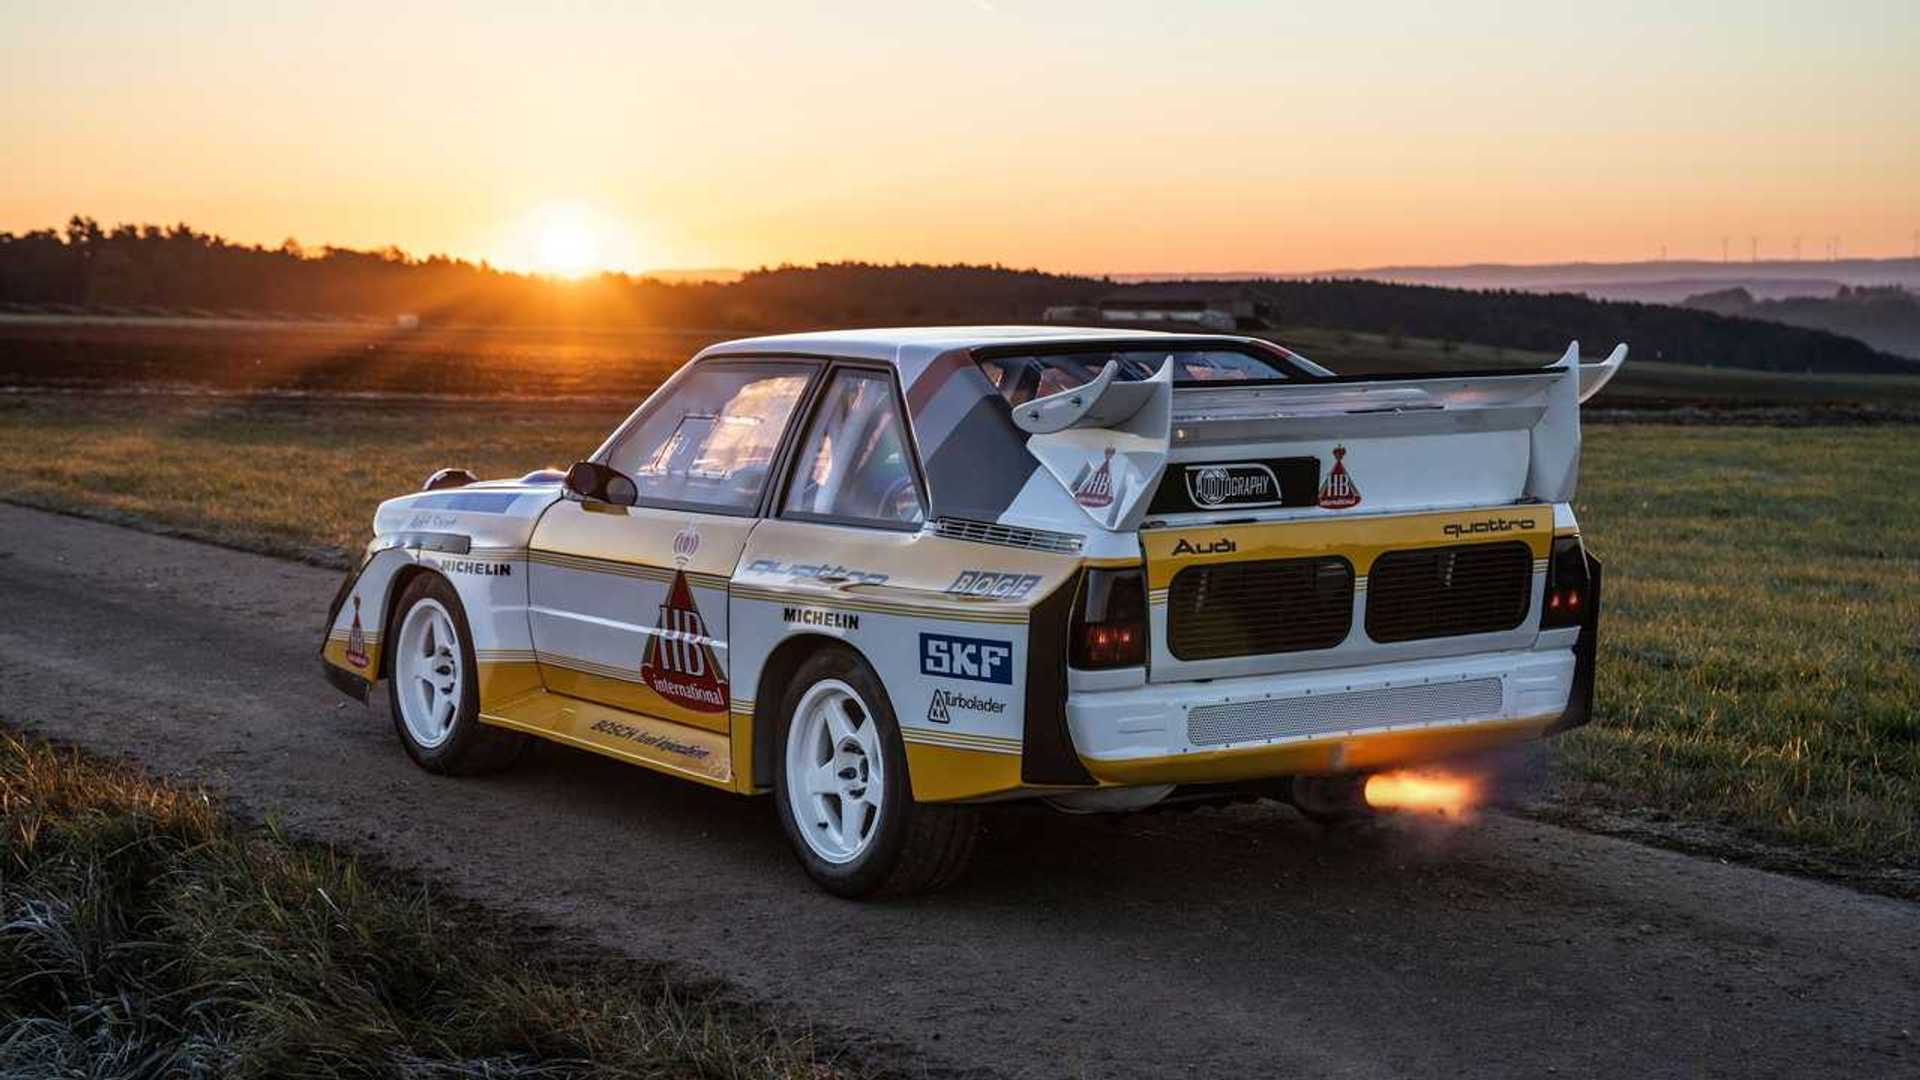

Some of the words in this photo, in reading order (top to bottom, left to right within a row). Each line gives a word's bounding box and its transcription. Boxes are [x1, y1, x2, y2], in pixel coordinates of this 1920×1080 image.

[1325, 473, 1349, 497] HB
[1443, 518, 1535, 538] quattro
[1171, 538, 1236, 556] Audi
[440, 560, 511, 576] MICHELIN
[951, 571, 1040, 599] BOGE
[783, 607, 859, 630] MICHELIN
[660, 606, 705, 677] HB
[924, 638, 1009, 679] SKF
[653, 673, 724, 706] international
[943, 690, 1006, 713] Turbolader
